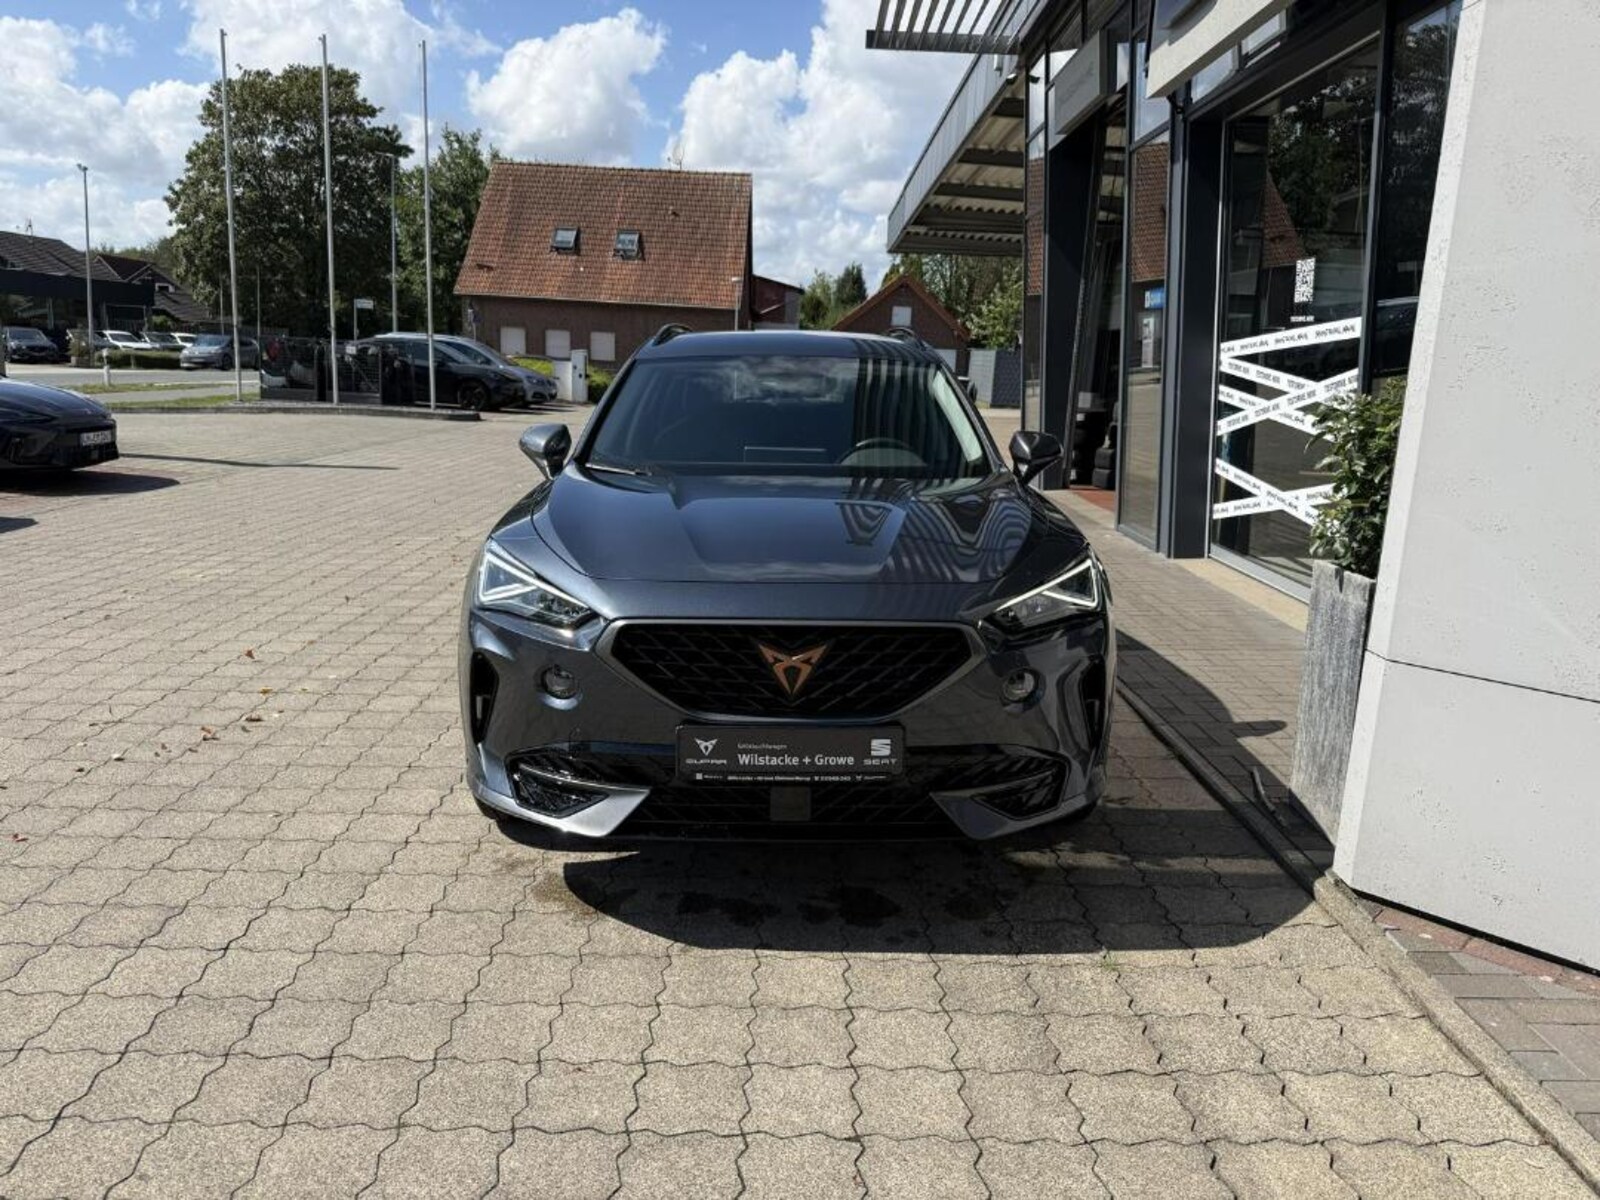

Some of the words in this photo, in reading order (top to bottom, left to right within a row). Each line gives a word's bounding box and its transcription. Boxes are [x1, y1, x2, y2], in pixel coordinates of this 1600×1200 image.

[738, 753, 799, 766] Wilstacke
[802, 756, 812, 765] +
[814, 753, 855, 766] Growe
